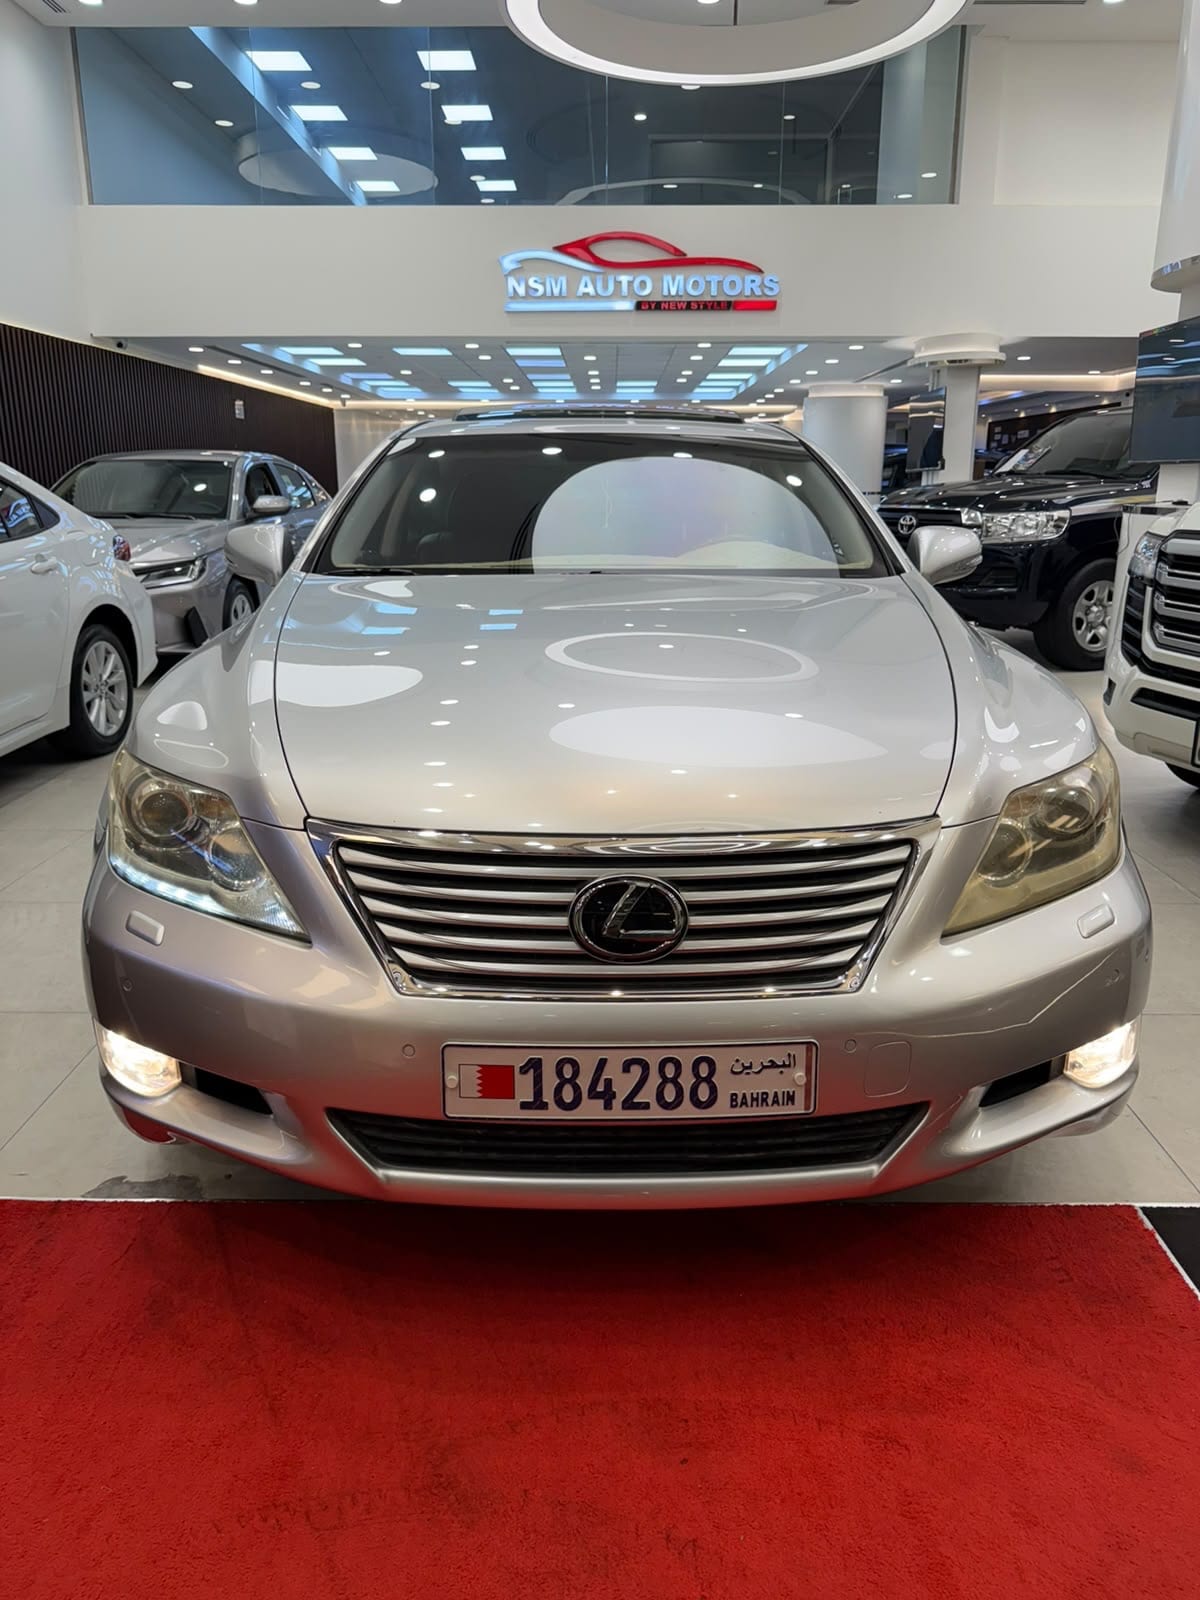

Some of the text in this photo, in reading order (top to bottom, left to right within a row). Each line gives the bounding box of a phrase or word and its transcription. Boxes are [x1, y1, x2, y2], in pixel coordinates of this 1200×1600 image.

[506, 273, 780, 297] NSM AUTO MOTORS
[641, 301, 728, 310] BY NEW STYLE
[730, 1052, 796, 1075] البحرين
[518, 1055, 719, 1111] 184288
[729, 1090, 796, 1108] BAHRAIN
